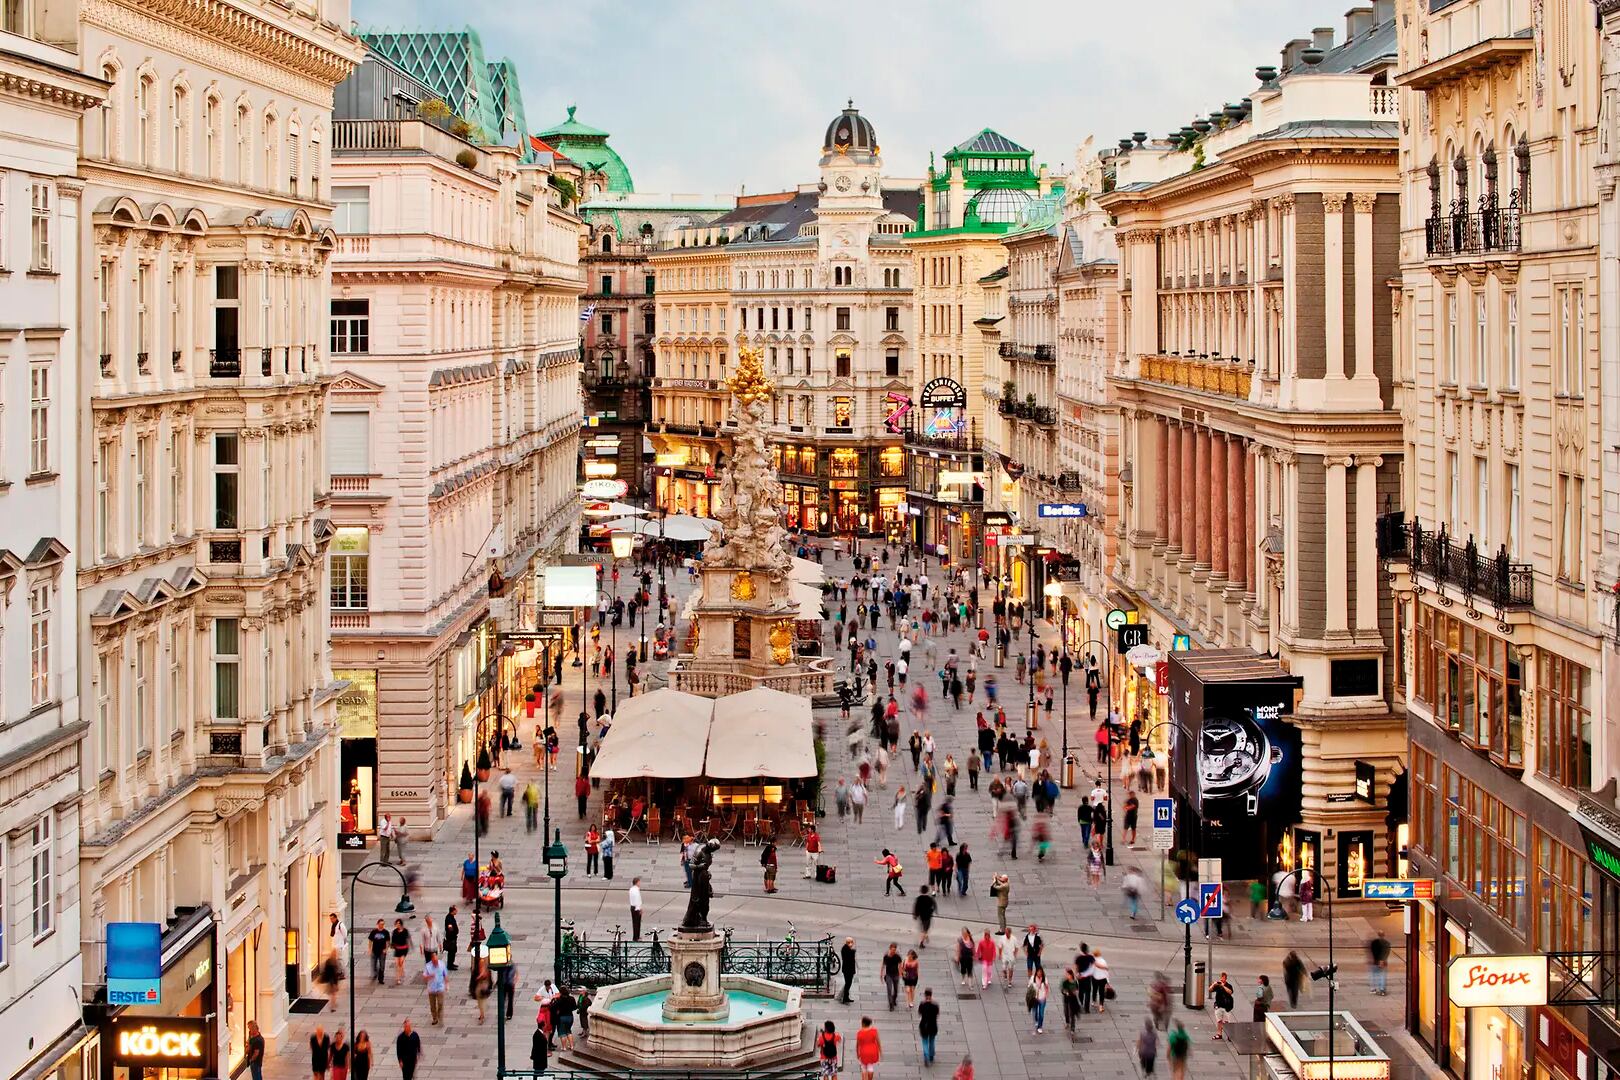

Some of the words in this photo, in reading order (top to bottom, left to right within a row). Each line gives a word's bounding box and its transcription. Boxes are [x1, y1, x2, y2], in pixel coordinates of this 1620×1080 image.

[1043, 505, 1081, 516] Berlitz
[1256, 712, 1279, 720] BLANC
[1463, 965, 1531, 989] Sioux
[109, 991, 146, 1003] ERSTE
[120, 1026, 201, 1057] KÖCK
